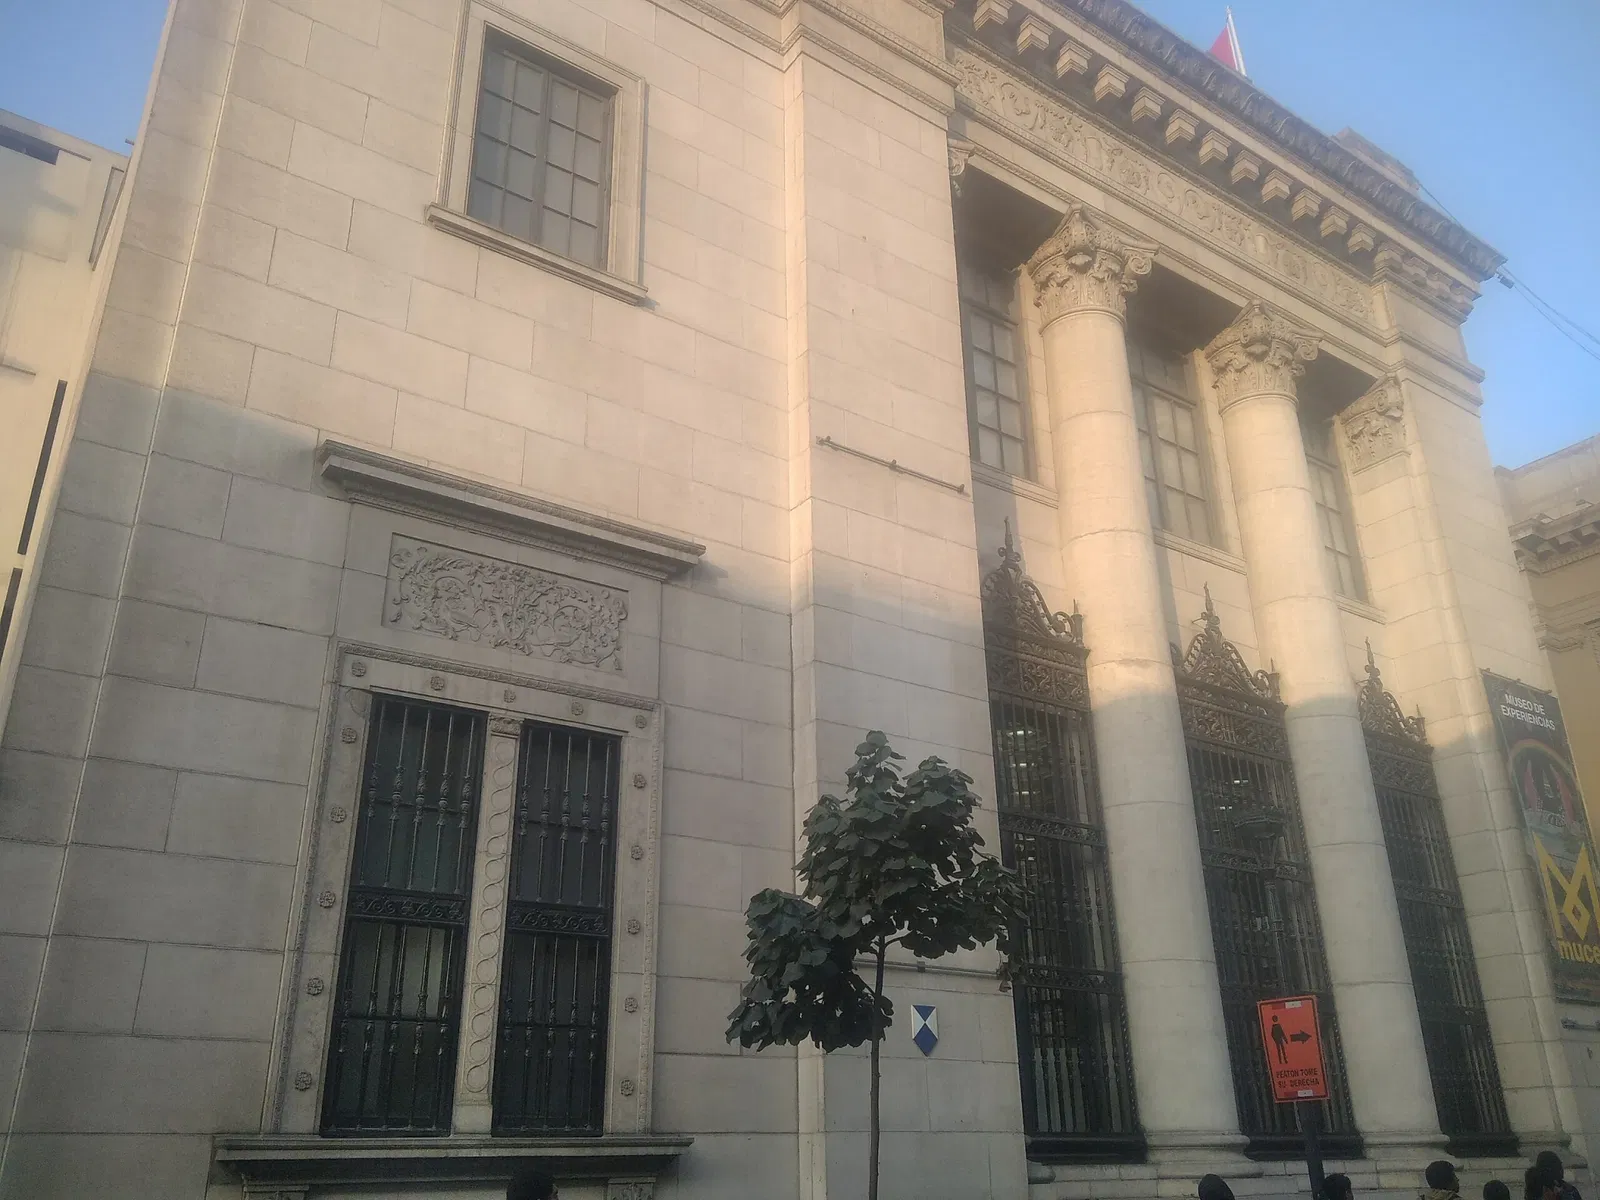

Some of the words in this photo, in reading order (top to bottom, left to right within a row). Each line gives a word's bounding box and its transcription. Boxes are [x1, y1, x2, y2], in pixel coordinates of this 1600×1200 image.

[1504, 693, 1533, 711] MUSEO
[1533, 702, 1546, 715] DE
[1500, 704, 1556, 730] EXPERIENCIAS
[1299, 1068, 1319, 1076] TOME
[1289, 1078, 1320, 1088] DERECHA
